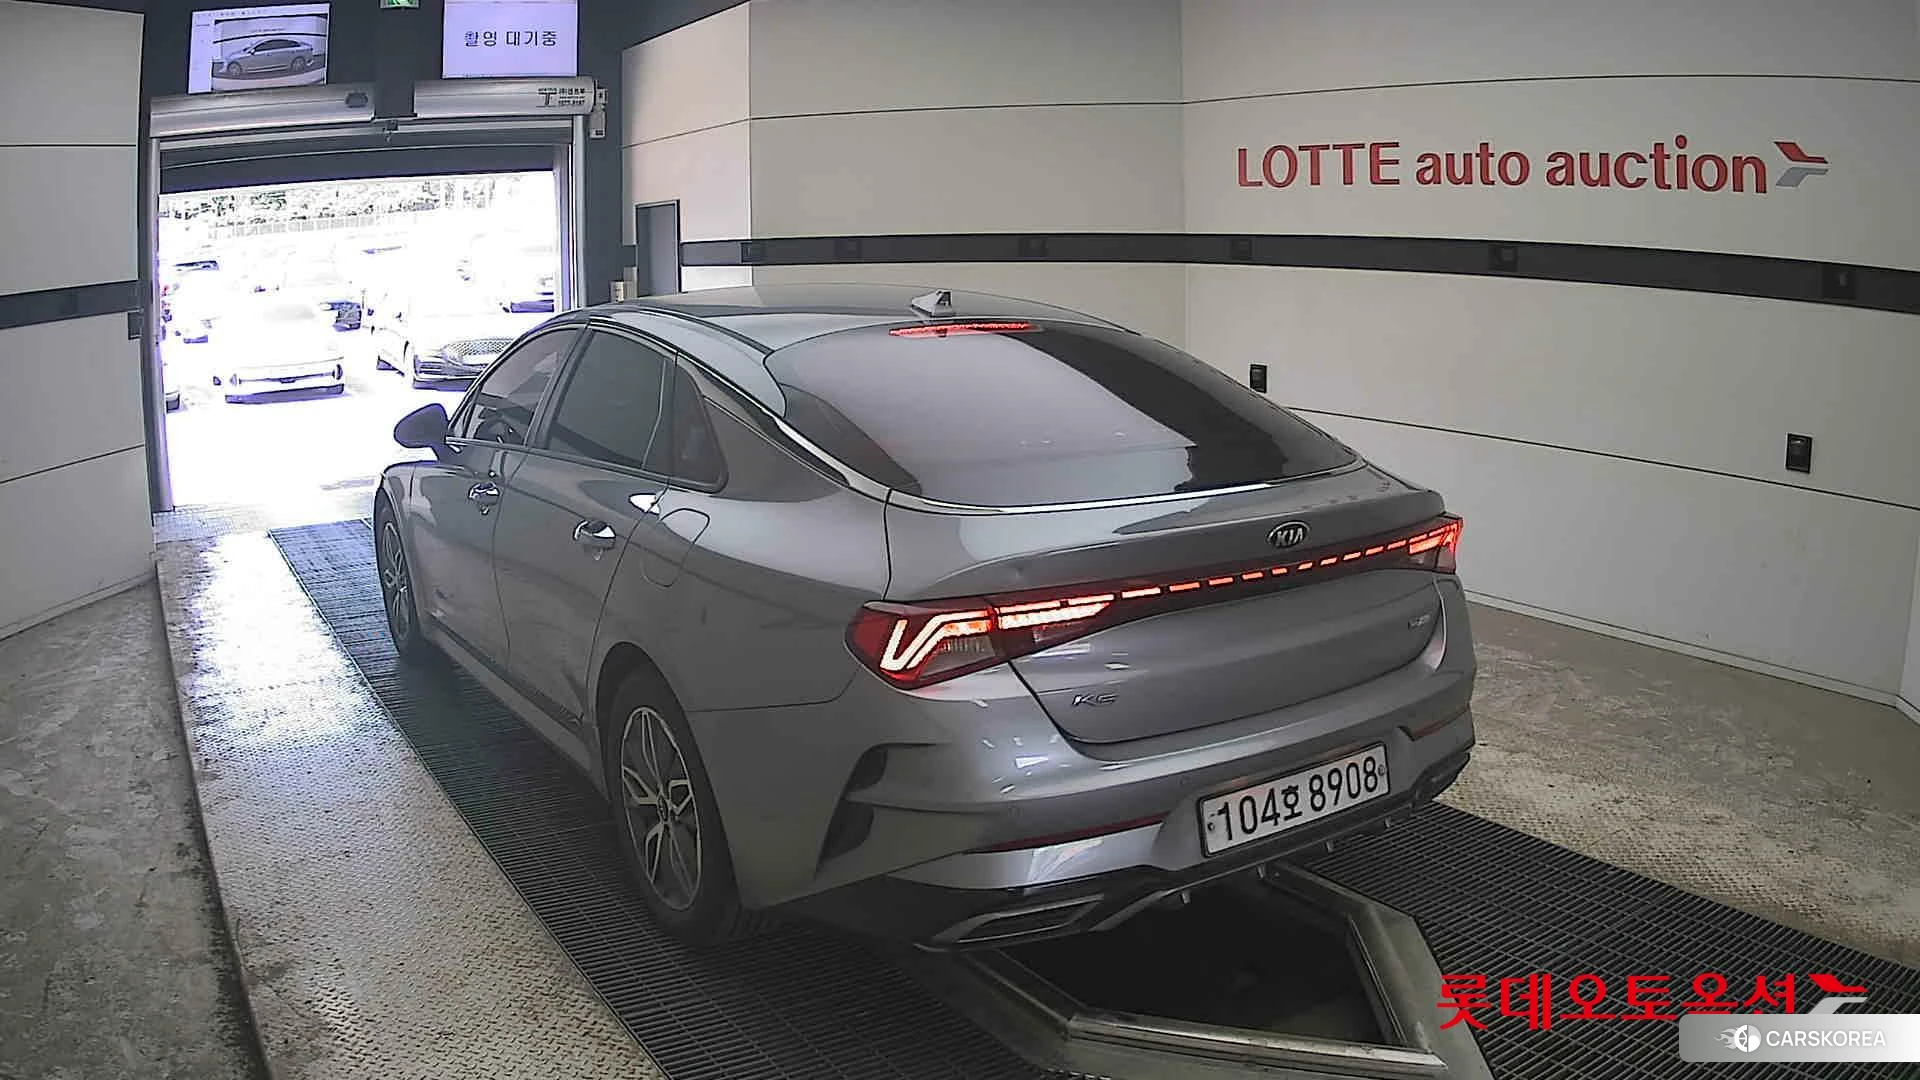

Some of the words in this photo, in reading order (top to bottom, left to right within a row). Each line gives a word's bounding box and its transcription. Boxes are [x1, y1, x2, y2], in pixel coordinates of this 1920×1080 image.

[505, 30, 558, 47] 대기중
[1237, 142, 1400, 188] LOTTE
[1415, 142, 1530, 186] auto
[1545, 134, 1767, 194] auction
[1275, 527, 1304, 547] KIA
[1217, 784, 1303, 841] 104호
[1308, 756, 1379, 812] 8908
